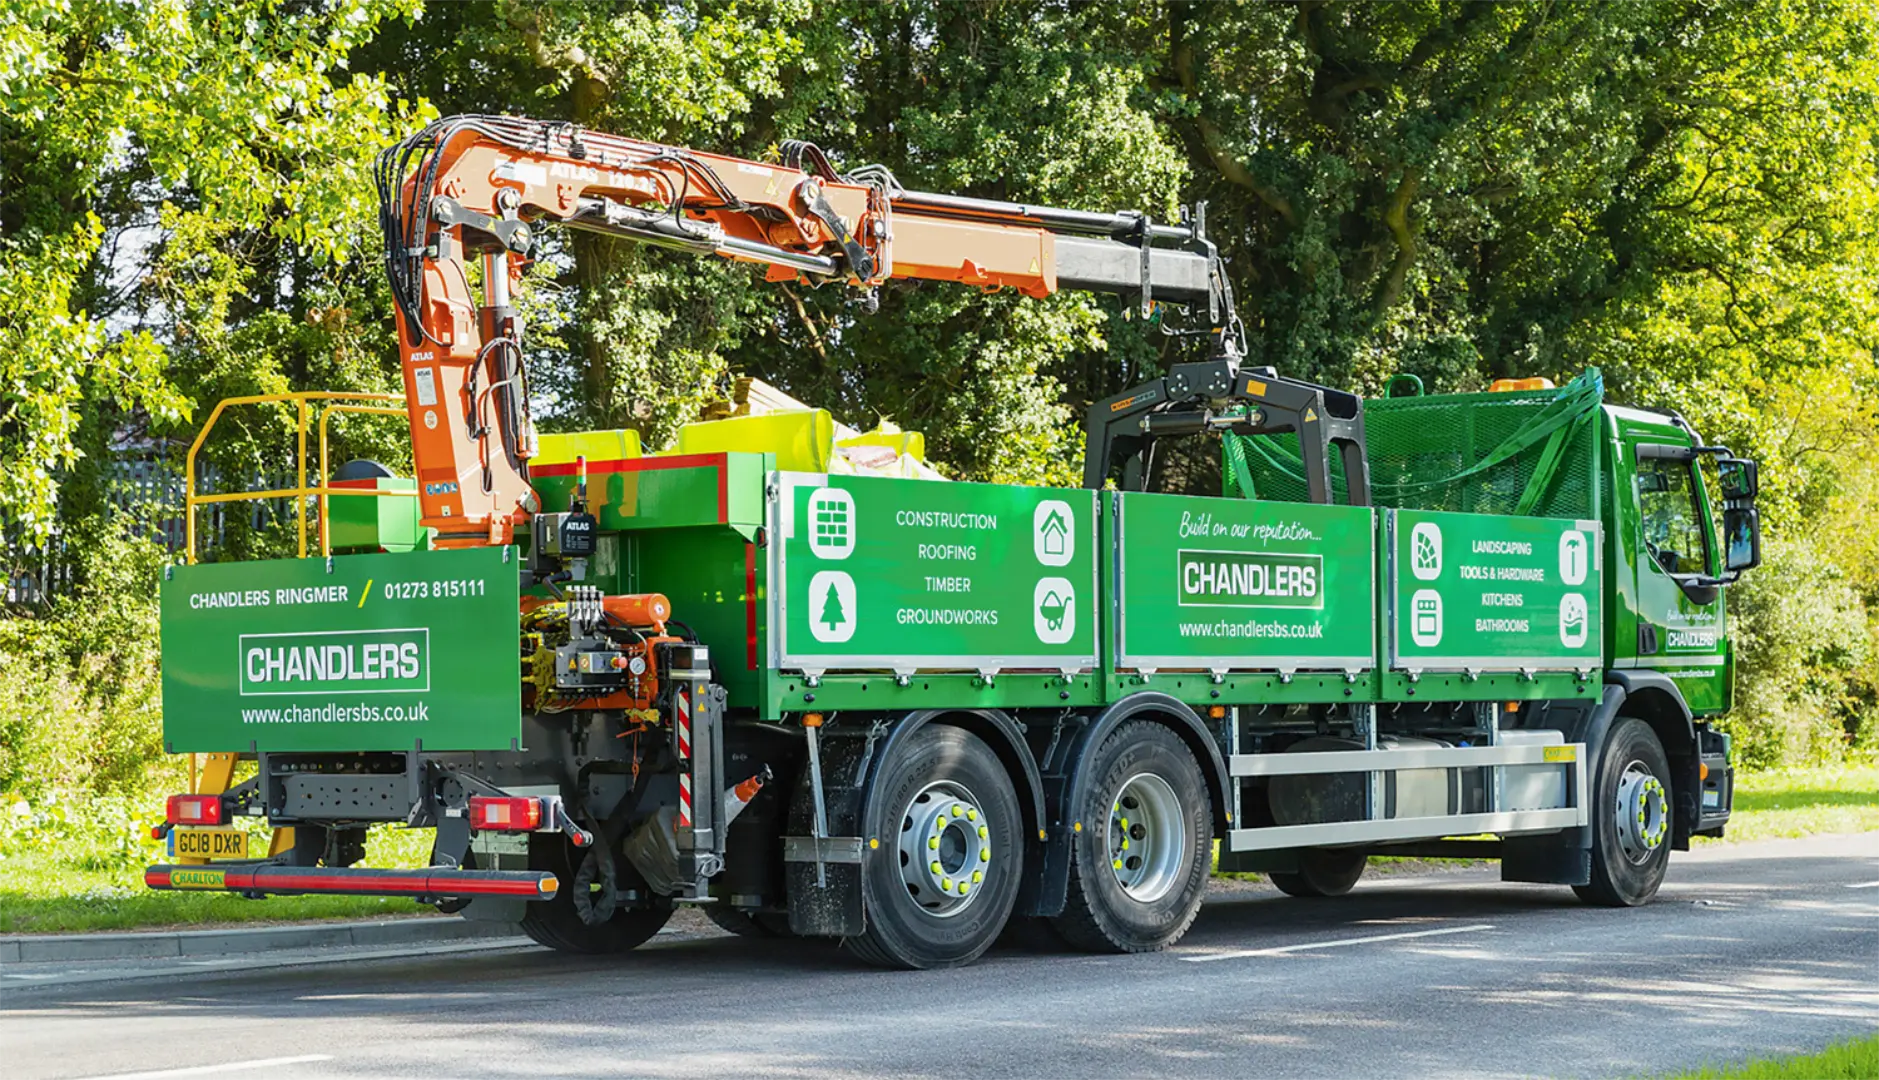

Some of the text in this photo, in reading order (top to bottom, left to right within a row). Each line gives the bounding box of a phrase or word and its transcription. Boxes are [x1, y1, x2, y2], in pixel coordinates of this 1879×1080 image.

[410, 352, 434, 361] ATLAS
[566, 522, 590, 530] ATLAS
[896, 511, 997, 530] CONSTRUCTION
[1179, 511, 1322, 547] Build on our reputation...
[918, 544, 977, 561] ROOFING
[1472, 540, 1532, 556] LANDSCAPING
[1185, 562, 1317, 597] CHANDLERS
[1459, 565, 1544, 582] TOOLS & HARDWARE
[924, 577, 971, 593] TIMBER
[190, 590, 270, 609] CHANDLERS
[276, 585, 348, 605] RINGMER
[384, 581, 428, 600] 01273
[432, 580, 485, 599] 815111
[1481, 592, 1524, 607] KITCHENS
[896, 608, 998, 625] GROUNDWORKS
[1180, 619, 1323, 638] www.chandlersbs.co.uk
[1475, 618, 1529, 633] BATHROOMS
[1668, 632, 1714, 647] CHANDLERS
[247, 643, 419, 683] CHANDLERS
[242, 701, 429, 724] www.chandlersbs.co.uk
[180, 833, 241, 853] GC18 DXR
[171, 872, 223, 885] CHARLTON
